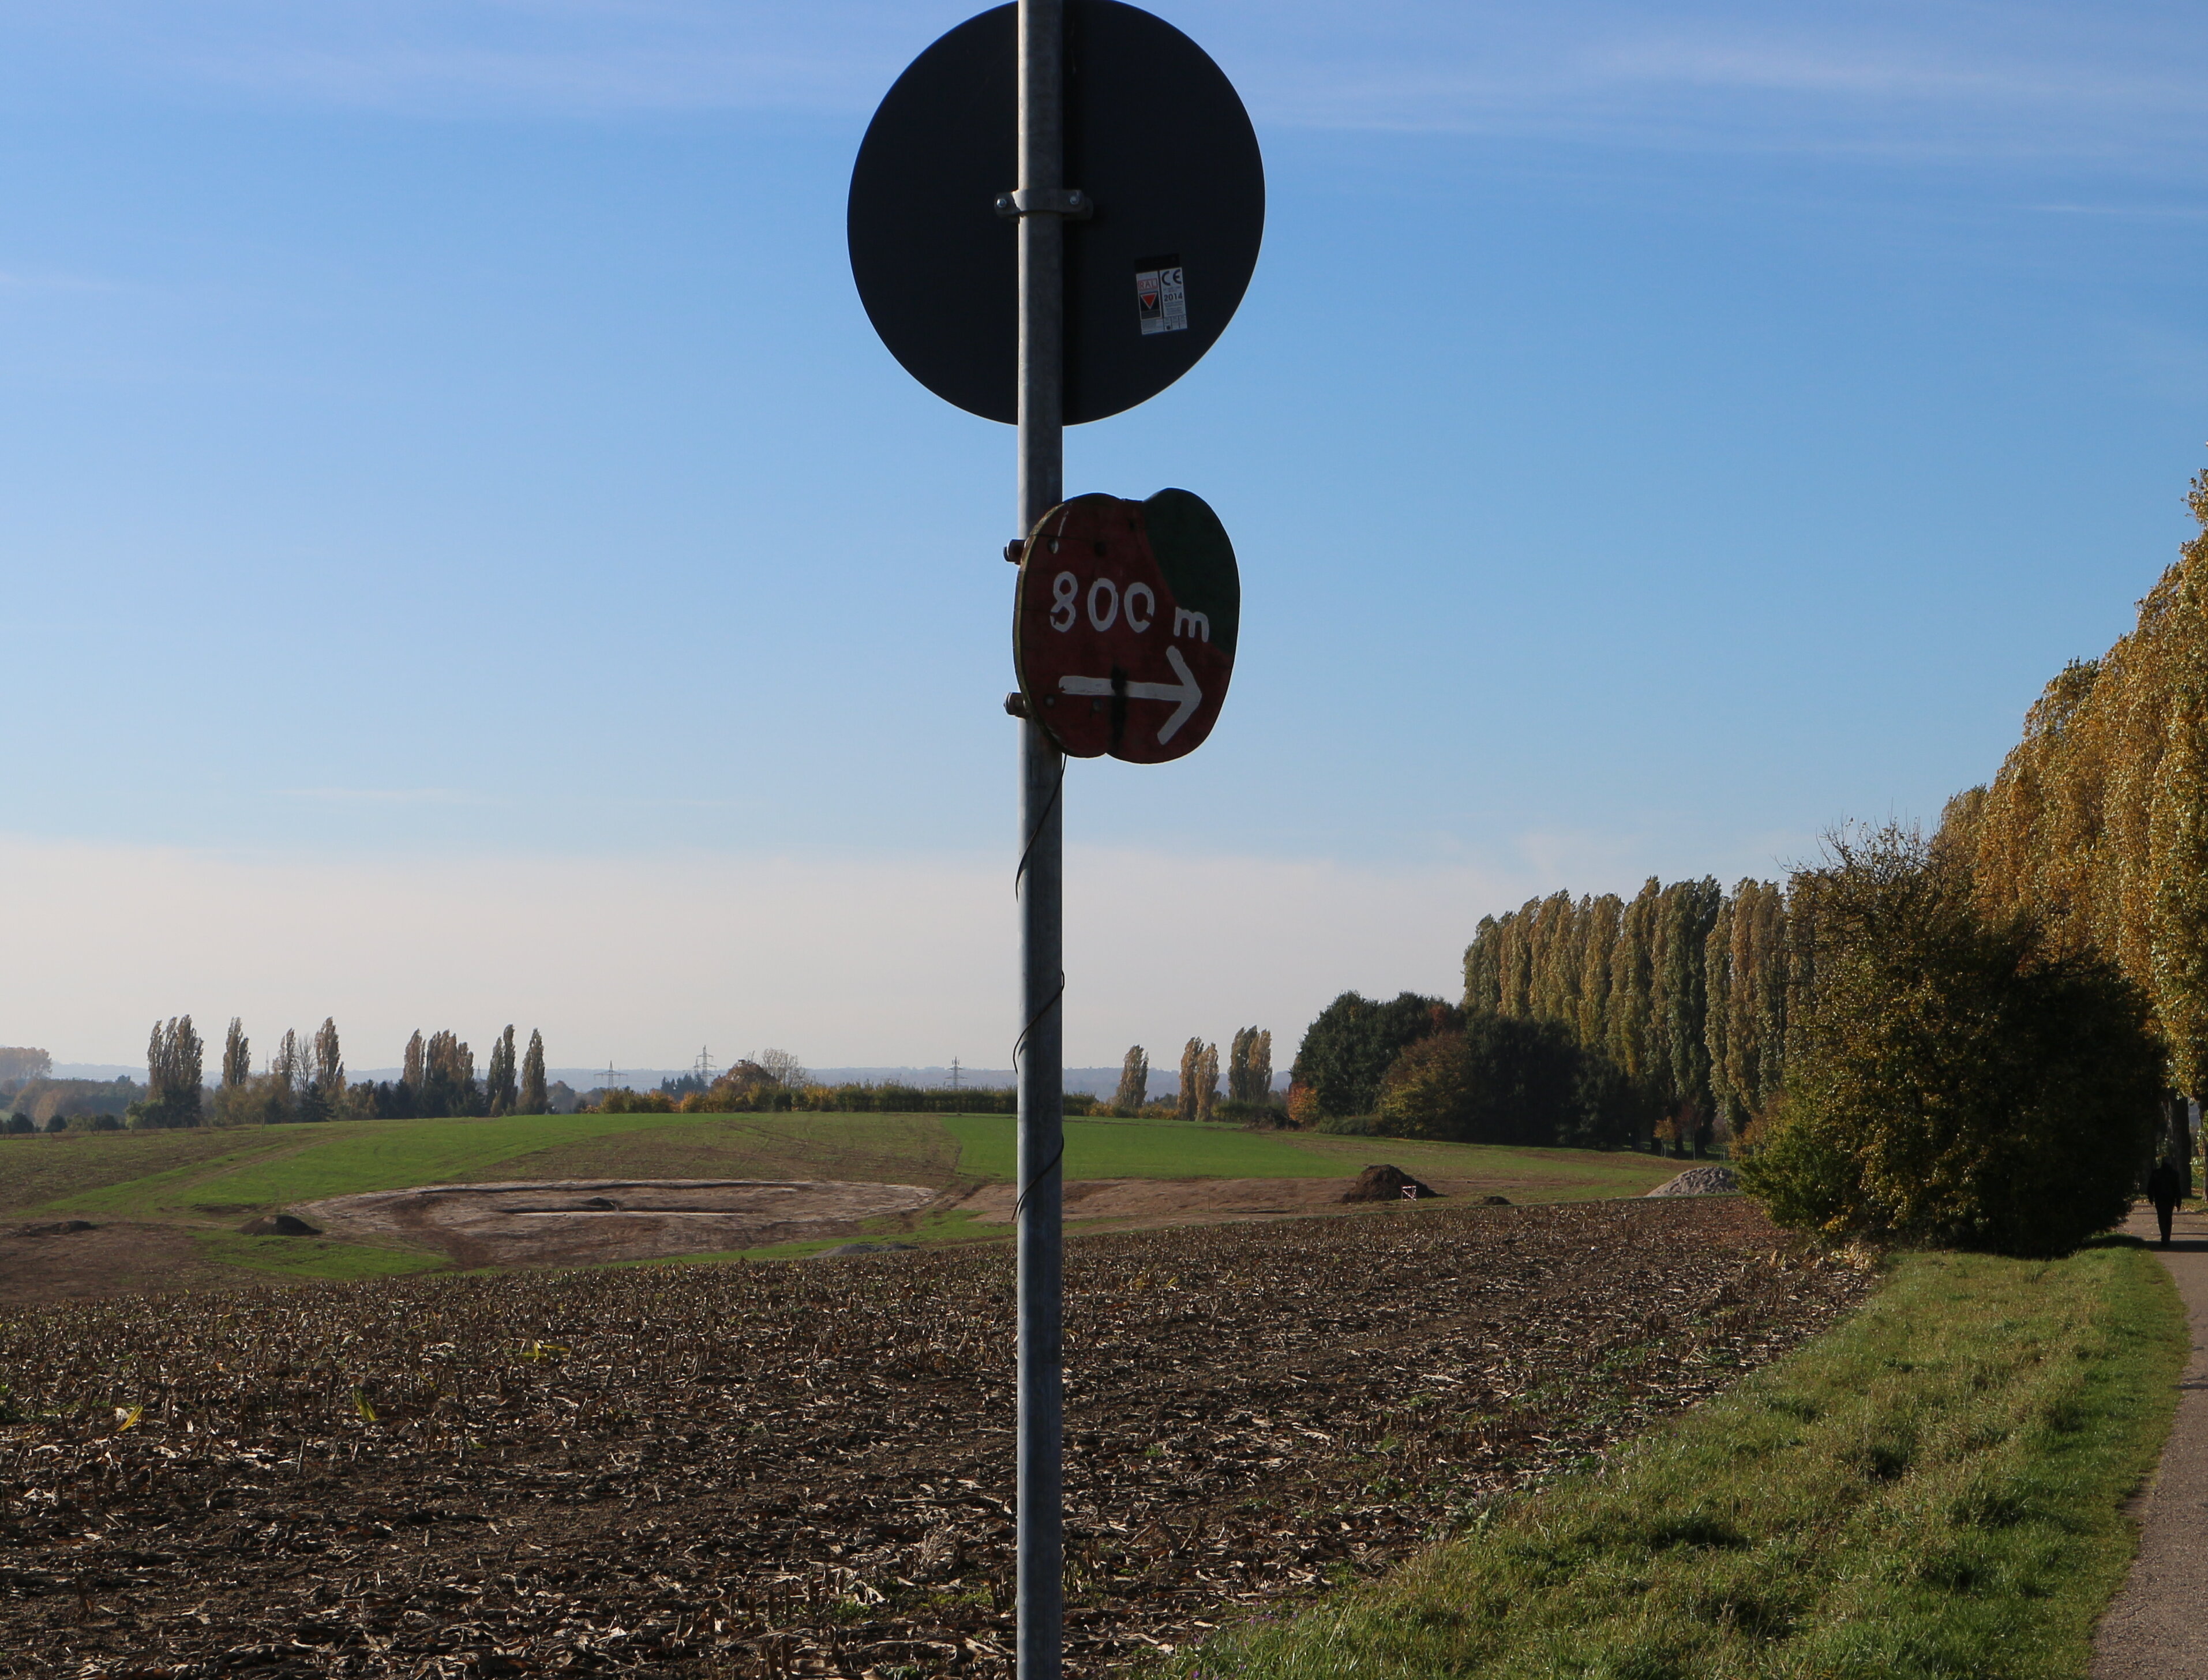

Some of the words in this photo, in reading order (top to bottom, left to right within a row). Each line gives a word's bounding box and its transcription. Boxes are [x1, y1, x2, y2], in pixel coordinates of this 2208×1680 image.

[1161, 269, 1182, 286] CE
[1164, 292, 1183, 302] 2014
[1050, 571, 1155, 633] 800
[1174, 606, 1209, 642] m
